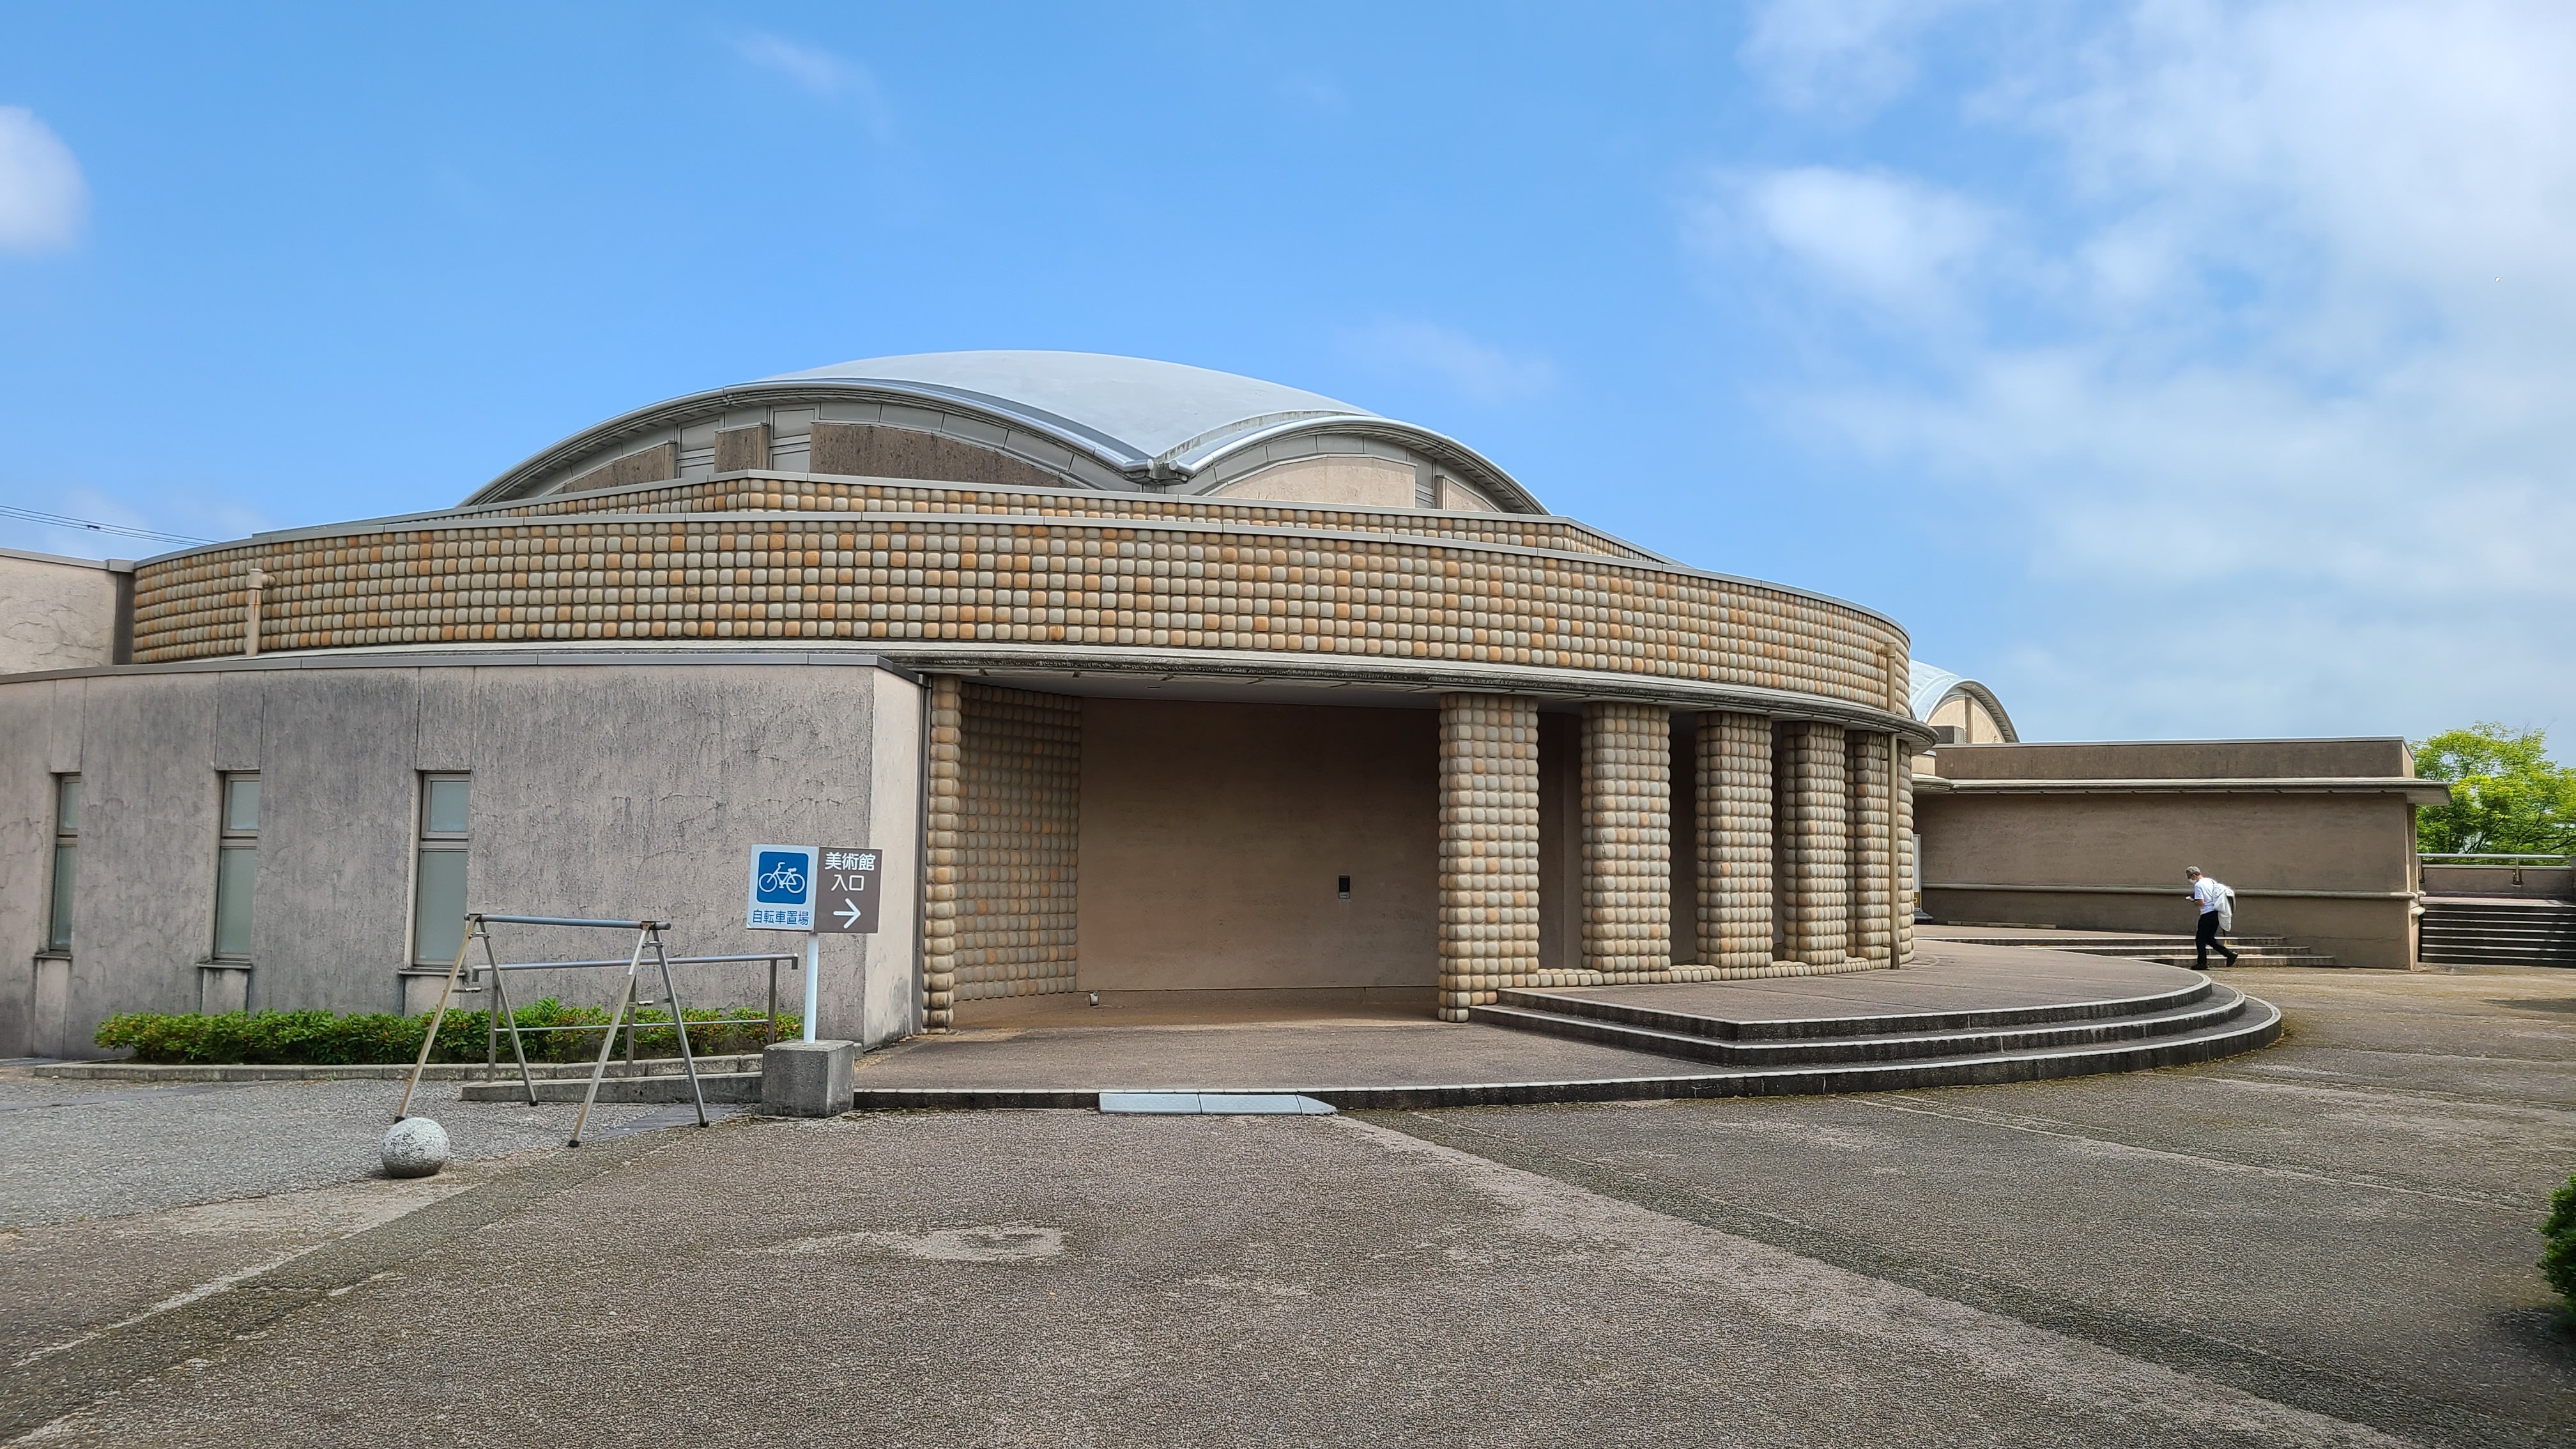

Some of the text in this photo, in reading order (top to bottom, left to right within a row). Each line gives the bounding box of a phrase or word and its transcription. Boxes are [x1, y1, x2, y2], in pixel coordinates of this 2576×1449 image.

[825, 852, 876, 871] 美術館
[831, 874, 864, 891] 入口
[753, 909, 809, 926] 自転車置場
